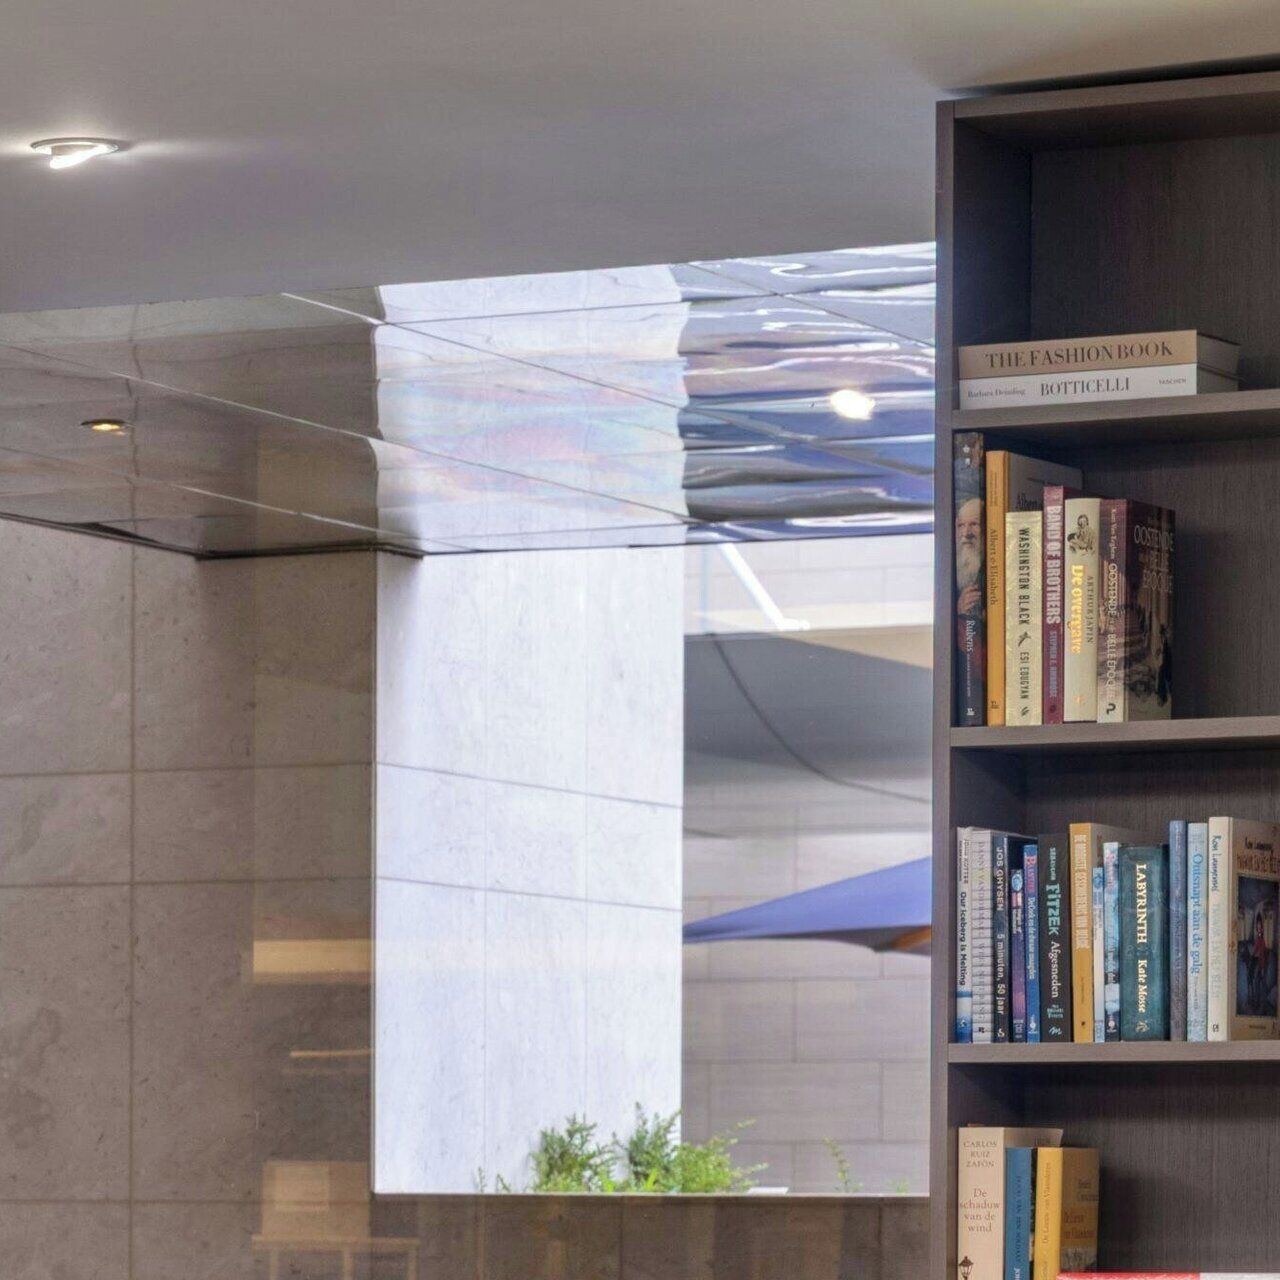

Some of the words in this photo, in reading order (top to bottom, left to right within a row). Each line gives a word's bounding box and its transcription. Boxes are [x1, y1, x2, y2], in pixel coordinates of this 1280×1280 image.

[985, 351, 1026, 370] THE
[1030, 344, 1114, 367] FASHION
[1117, 340, 1174, 361] BOOK
[1040, 376, 1130, 398] BOTTICELLI
[1158, 377, 1188, 387] TASCHEN
[1046, 505, 1063, 540] BAND
[990, 527, 999, 556] Albert
[1046, 541, 1063, 557] OF
[1134, 524, 1175, 551] OOSTENDE
[1017, 527, 1031, 590] WASHINGTON
[990, 564, 999, 607] Elisabeth
[1071, 564, 1085, 586] De
[1046, 559, 1062, 626] BROTHERS
[1086, 575, 1095, 615] ARTHUR
[1107, 563, 1118, 617] OOSTENDE
[1018, 594, 1031, 626] BLACK
[1067, 587, 1085, 655] overgave
[967, 619, 976, 654] Rubens
[1086, 616, 1094, 644] JAPIN
[1020, 651, 1030, 664] ESI
[1020, 666, 1030, 700] EDUGYAN
[995, 846, 1004, 867] JOS
[995, 869, 1005, 912] GHYSEN
[1189, 852, 1204, 908] Ontsnapt
[1135, 863, 1148, 944] LABYRINTH
[1191, 909, 1203, 932] aan
[1191, 933, 1203, 949] de
[994, 941, 1005, 981] minuten,
[1049, 941, 1061, 999] Afgesneden
[1137, 959, 1148, 984] Kate
[1189, 950, 1203, 975] galg
[996, 983, 1005, 995] 50
[1138, 984, 1148, 1014] Mosse
[995, 996, 1005, 1015] jaar
[962, 1140, 998, 1149] CARLOS
[970, 1150, 991, 1159] RUIZ
[958, 1200, 1001, 1210] schaduw
[973, 1187, 988, 1199] De
[963, 1212, 983, 1222] van
[984, 1212, 997, 1222] de
[967, 1222, 993, 1233] wind
